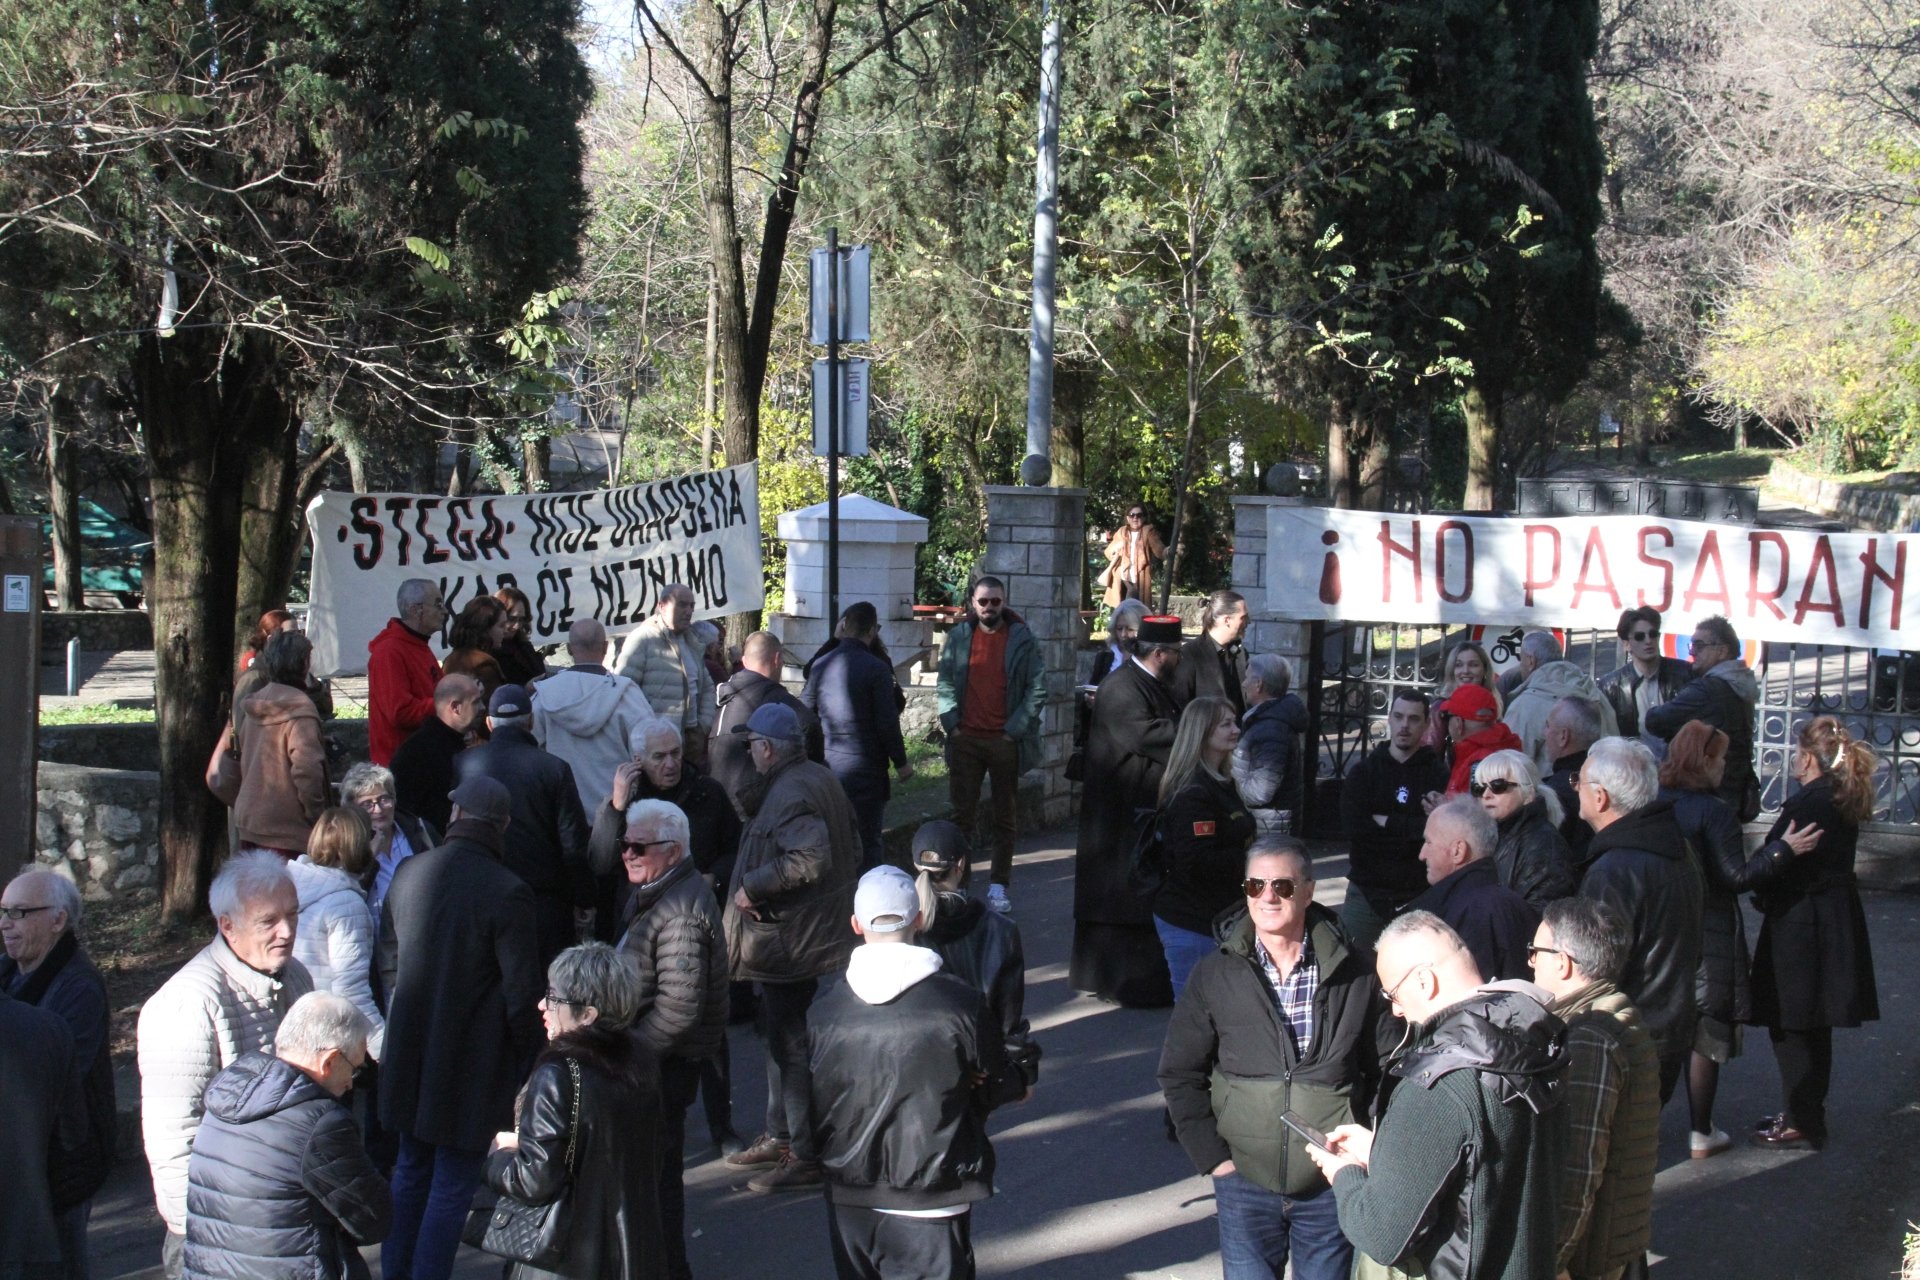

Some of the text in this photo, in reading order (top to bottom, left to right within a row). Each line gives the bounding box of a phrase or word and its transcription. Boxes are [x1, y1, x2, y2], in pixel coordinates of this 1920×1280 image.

[524, 493, 602, 556] NIJE
[604, 469, 747, 548] UHAPSENA
[1551, 486, 1744, 522] ГОРИЦА
[536, 561, 575, 637] ĆE
[1522, 524, 1908, 631] PASARAN
